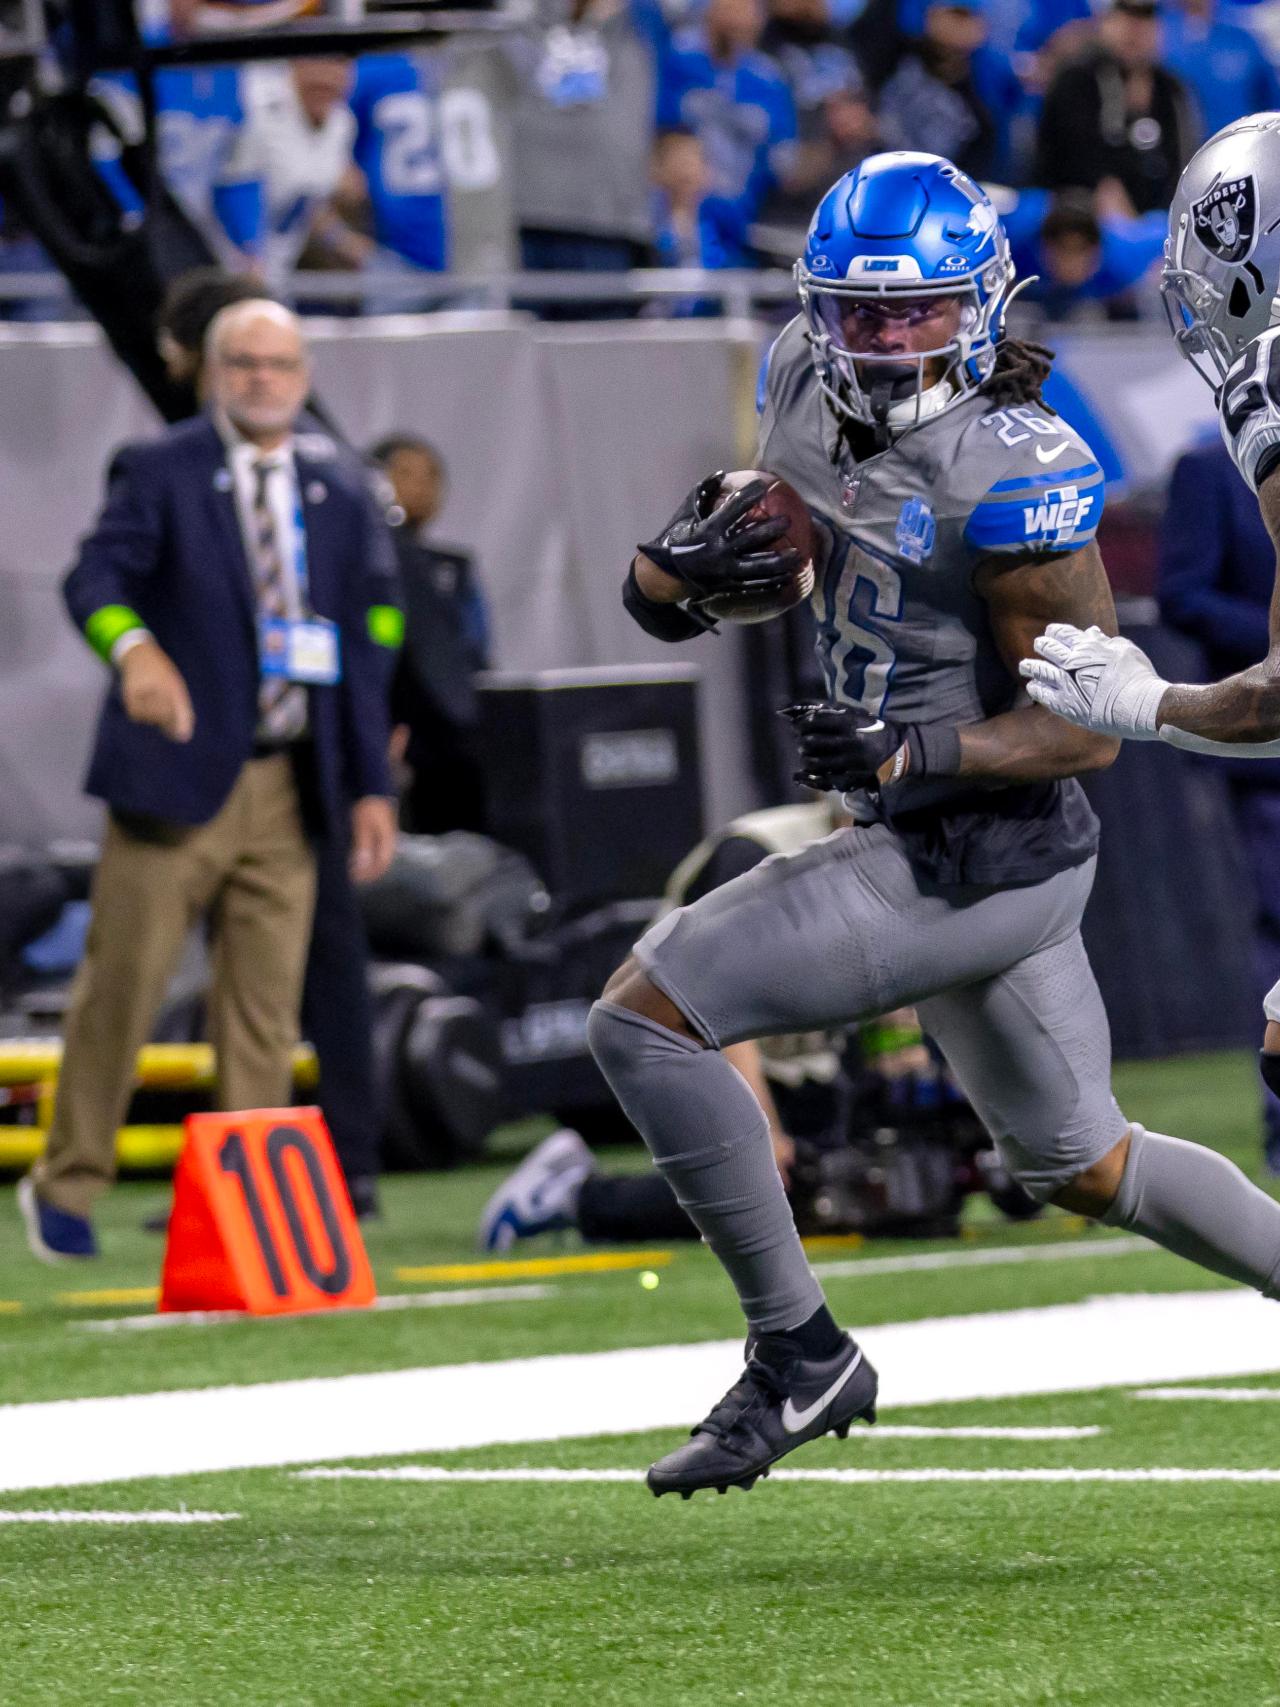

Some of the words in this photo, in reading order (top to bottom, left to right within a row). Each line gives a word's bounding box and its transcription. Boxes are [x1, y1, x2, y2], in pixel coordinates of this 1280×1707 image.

[372, 90, 497, 194] 20
[1197, 180, 1247, 213] RAIDERS
[978, 408, 1061, 447] 26
[1024, 495, 1094, 535] WCF
[219, 1126, 351, 1297] 10
